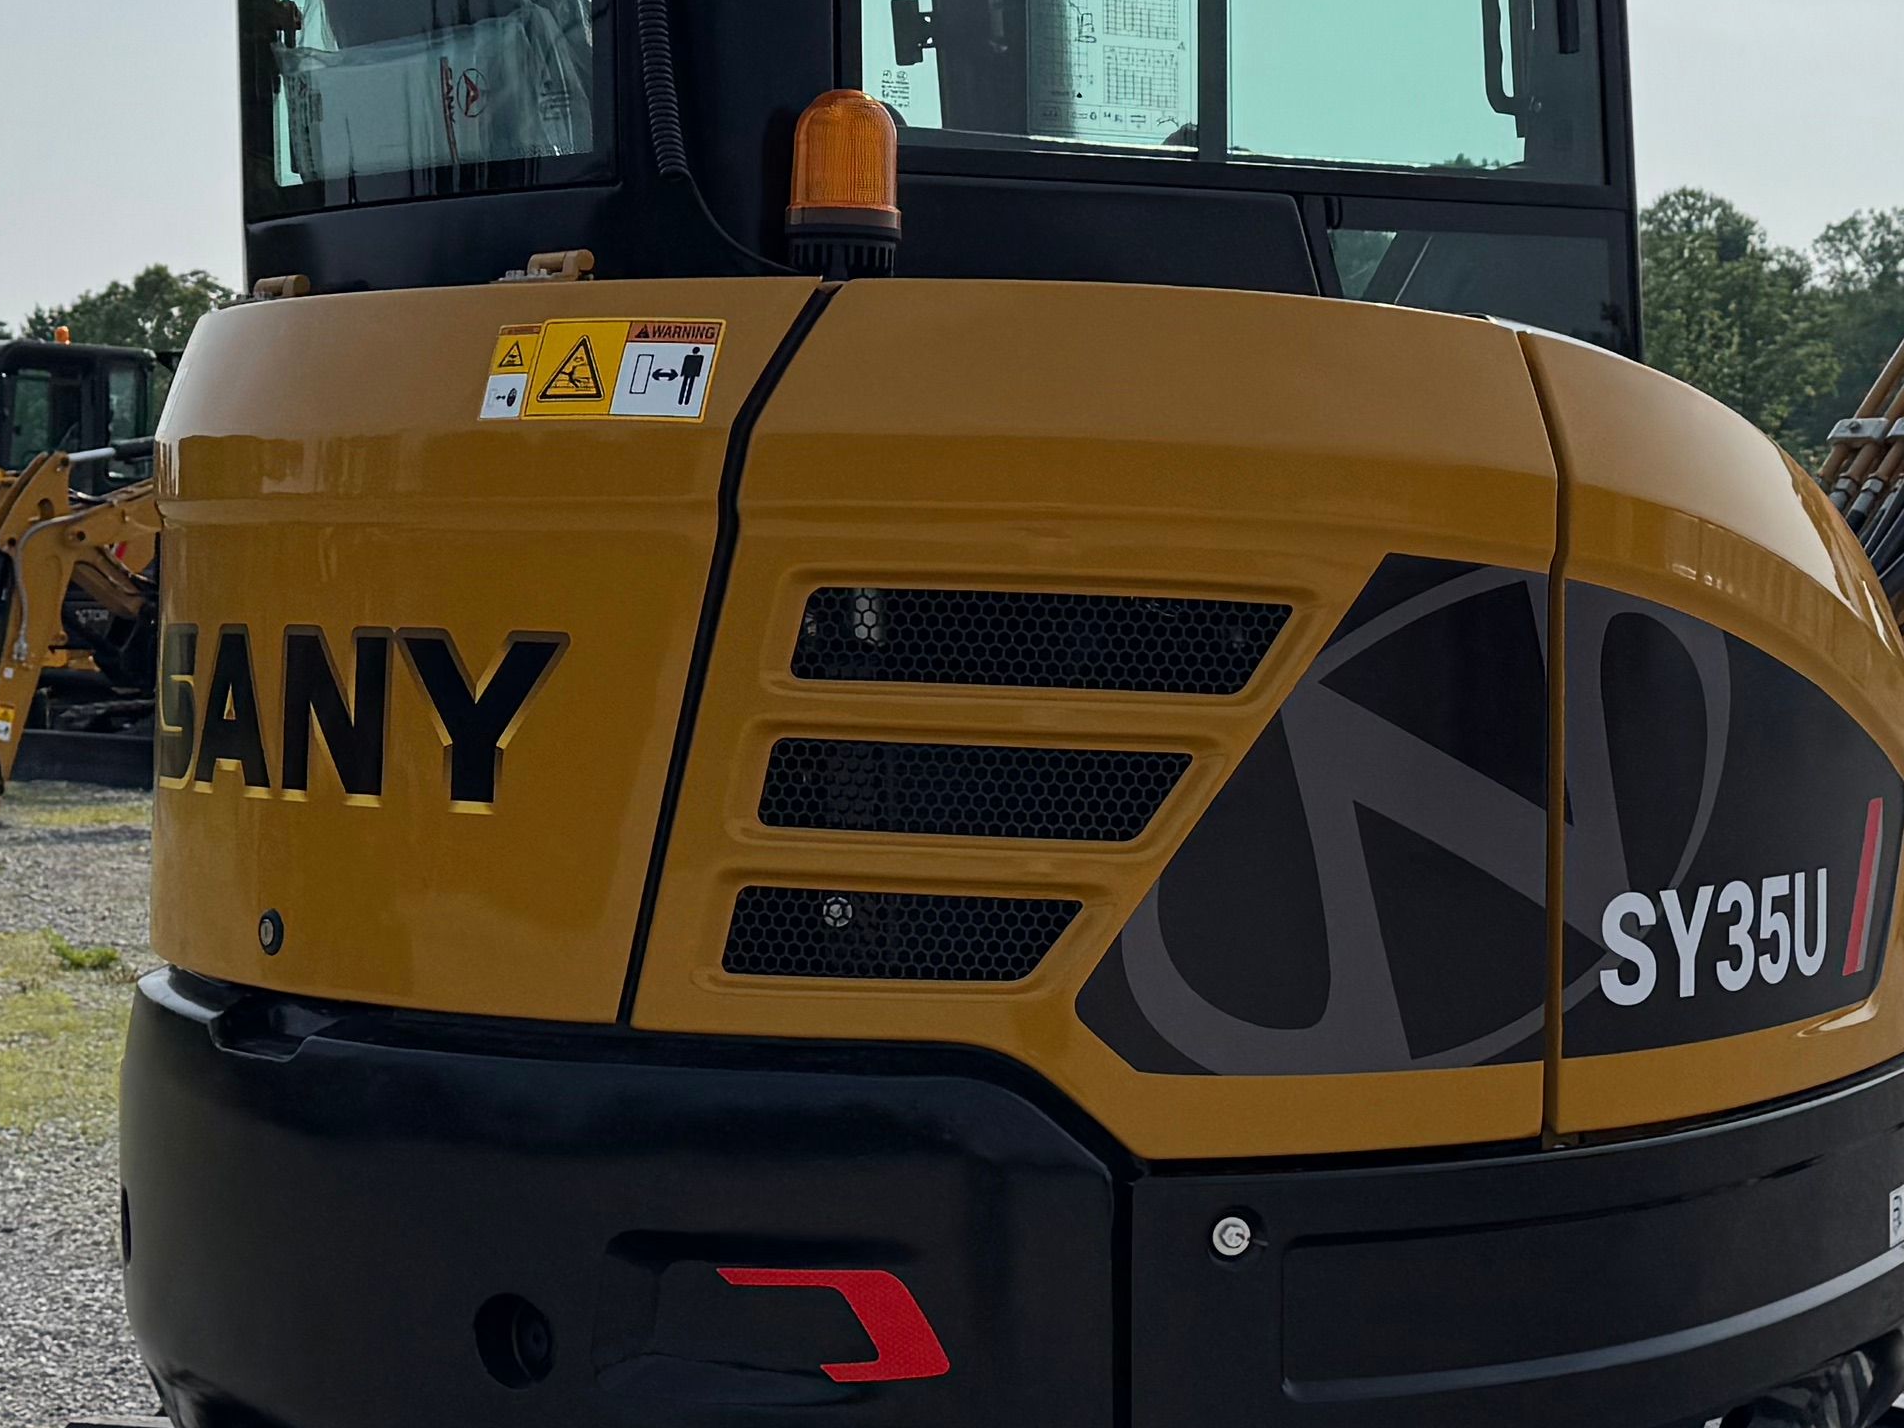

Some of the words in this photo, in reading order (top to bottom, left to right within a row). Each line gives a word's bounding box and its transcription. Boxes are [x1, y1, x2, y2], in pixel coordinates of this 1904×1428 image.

[651, 324, 716, 340] WARNING
[159, 623, 571, 814] SANY
[1599, 868, 1827, 1007] SY35U
